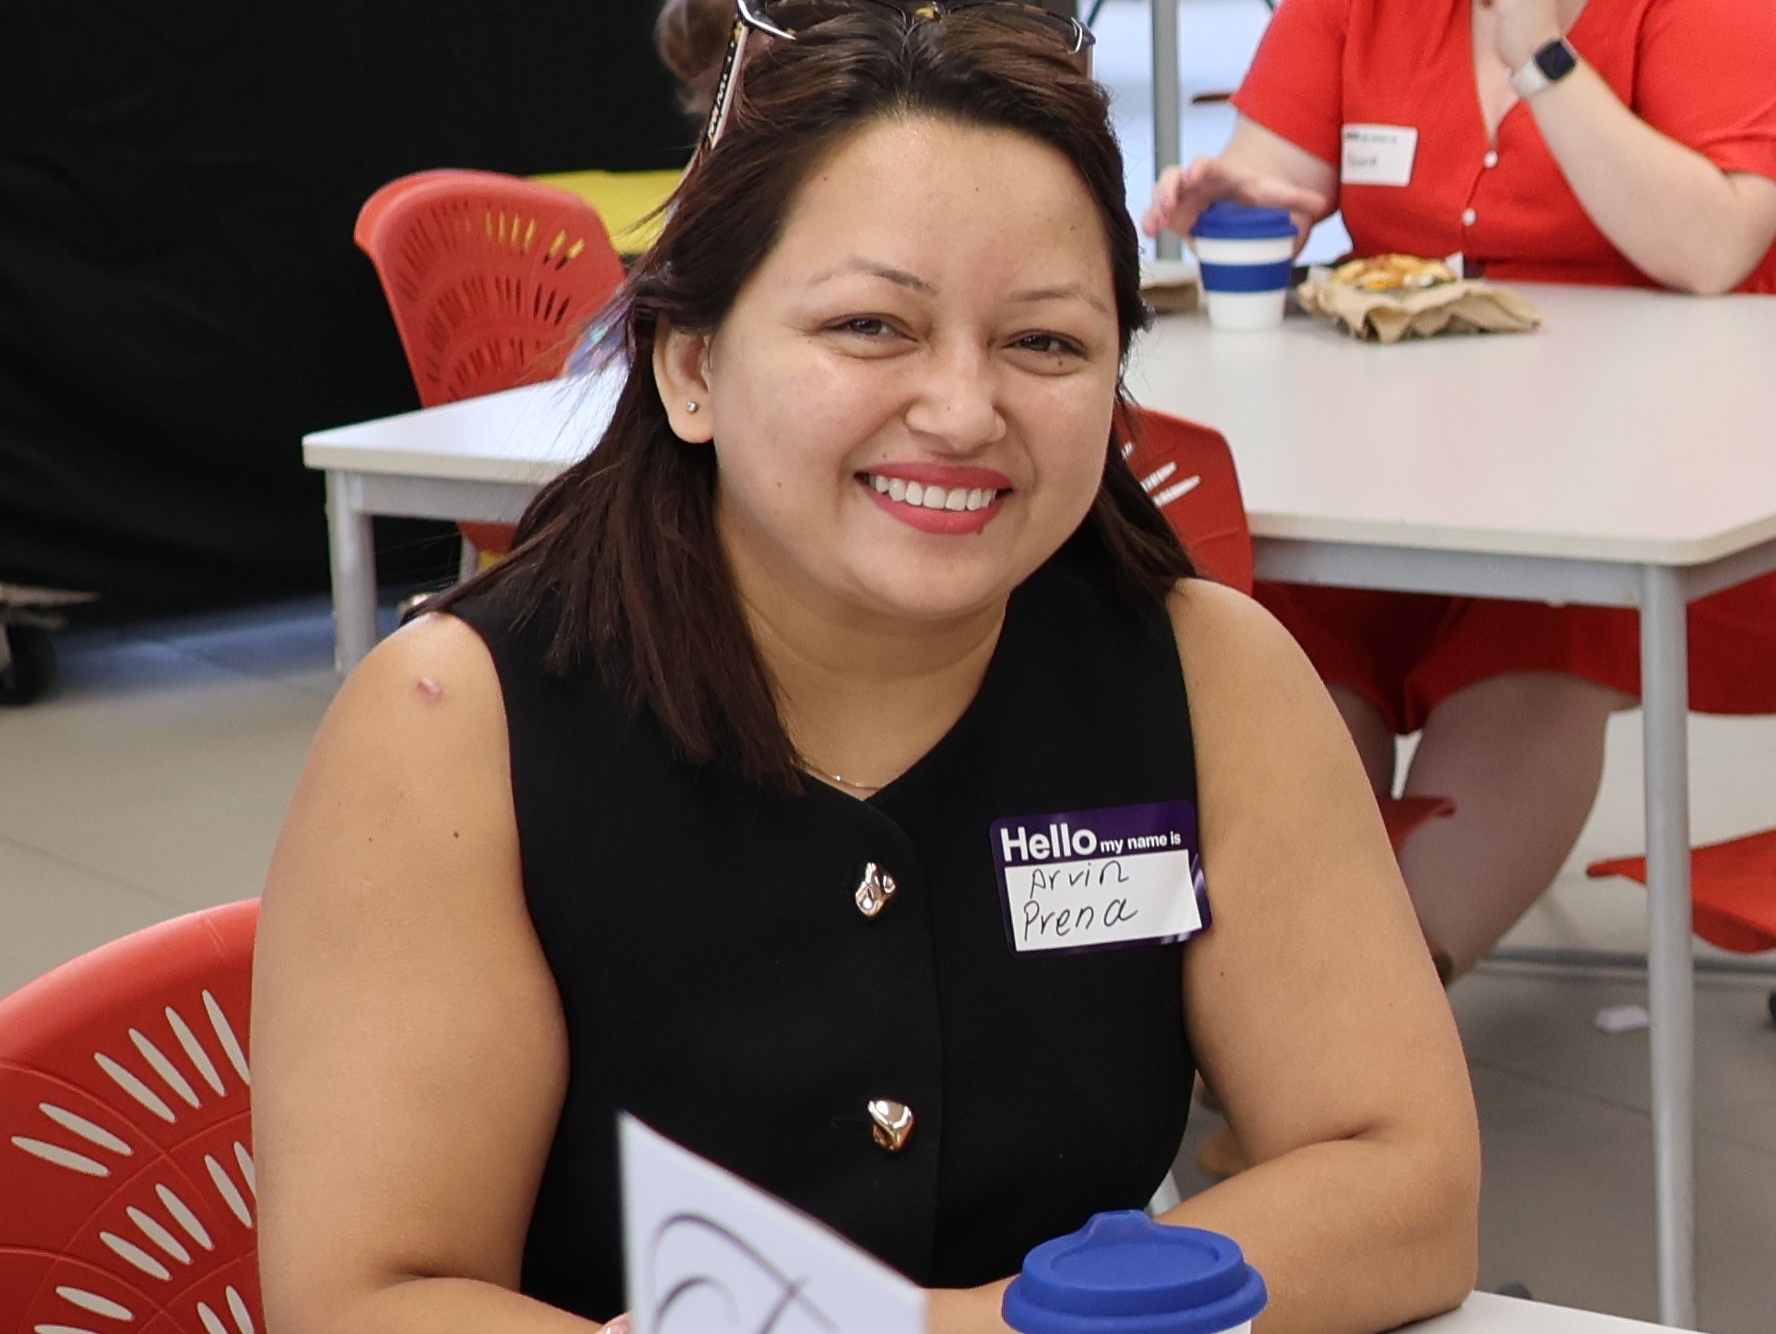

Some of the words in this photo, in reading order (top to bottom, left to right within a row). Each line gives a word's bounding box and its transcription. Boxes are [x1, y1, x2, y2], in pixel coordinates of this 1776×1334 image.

[1000, 823, 1098, 862] Hello
[1100, 838, 1124, 855] my
[1127, 832, 1168, 850] name
[1170, 830, 1182, 846] is
[1029, 859, 1130, 899] Arvin
[1022, 897, 1139, 943] Prena
